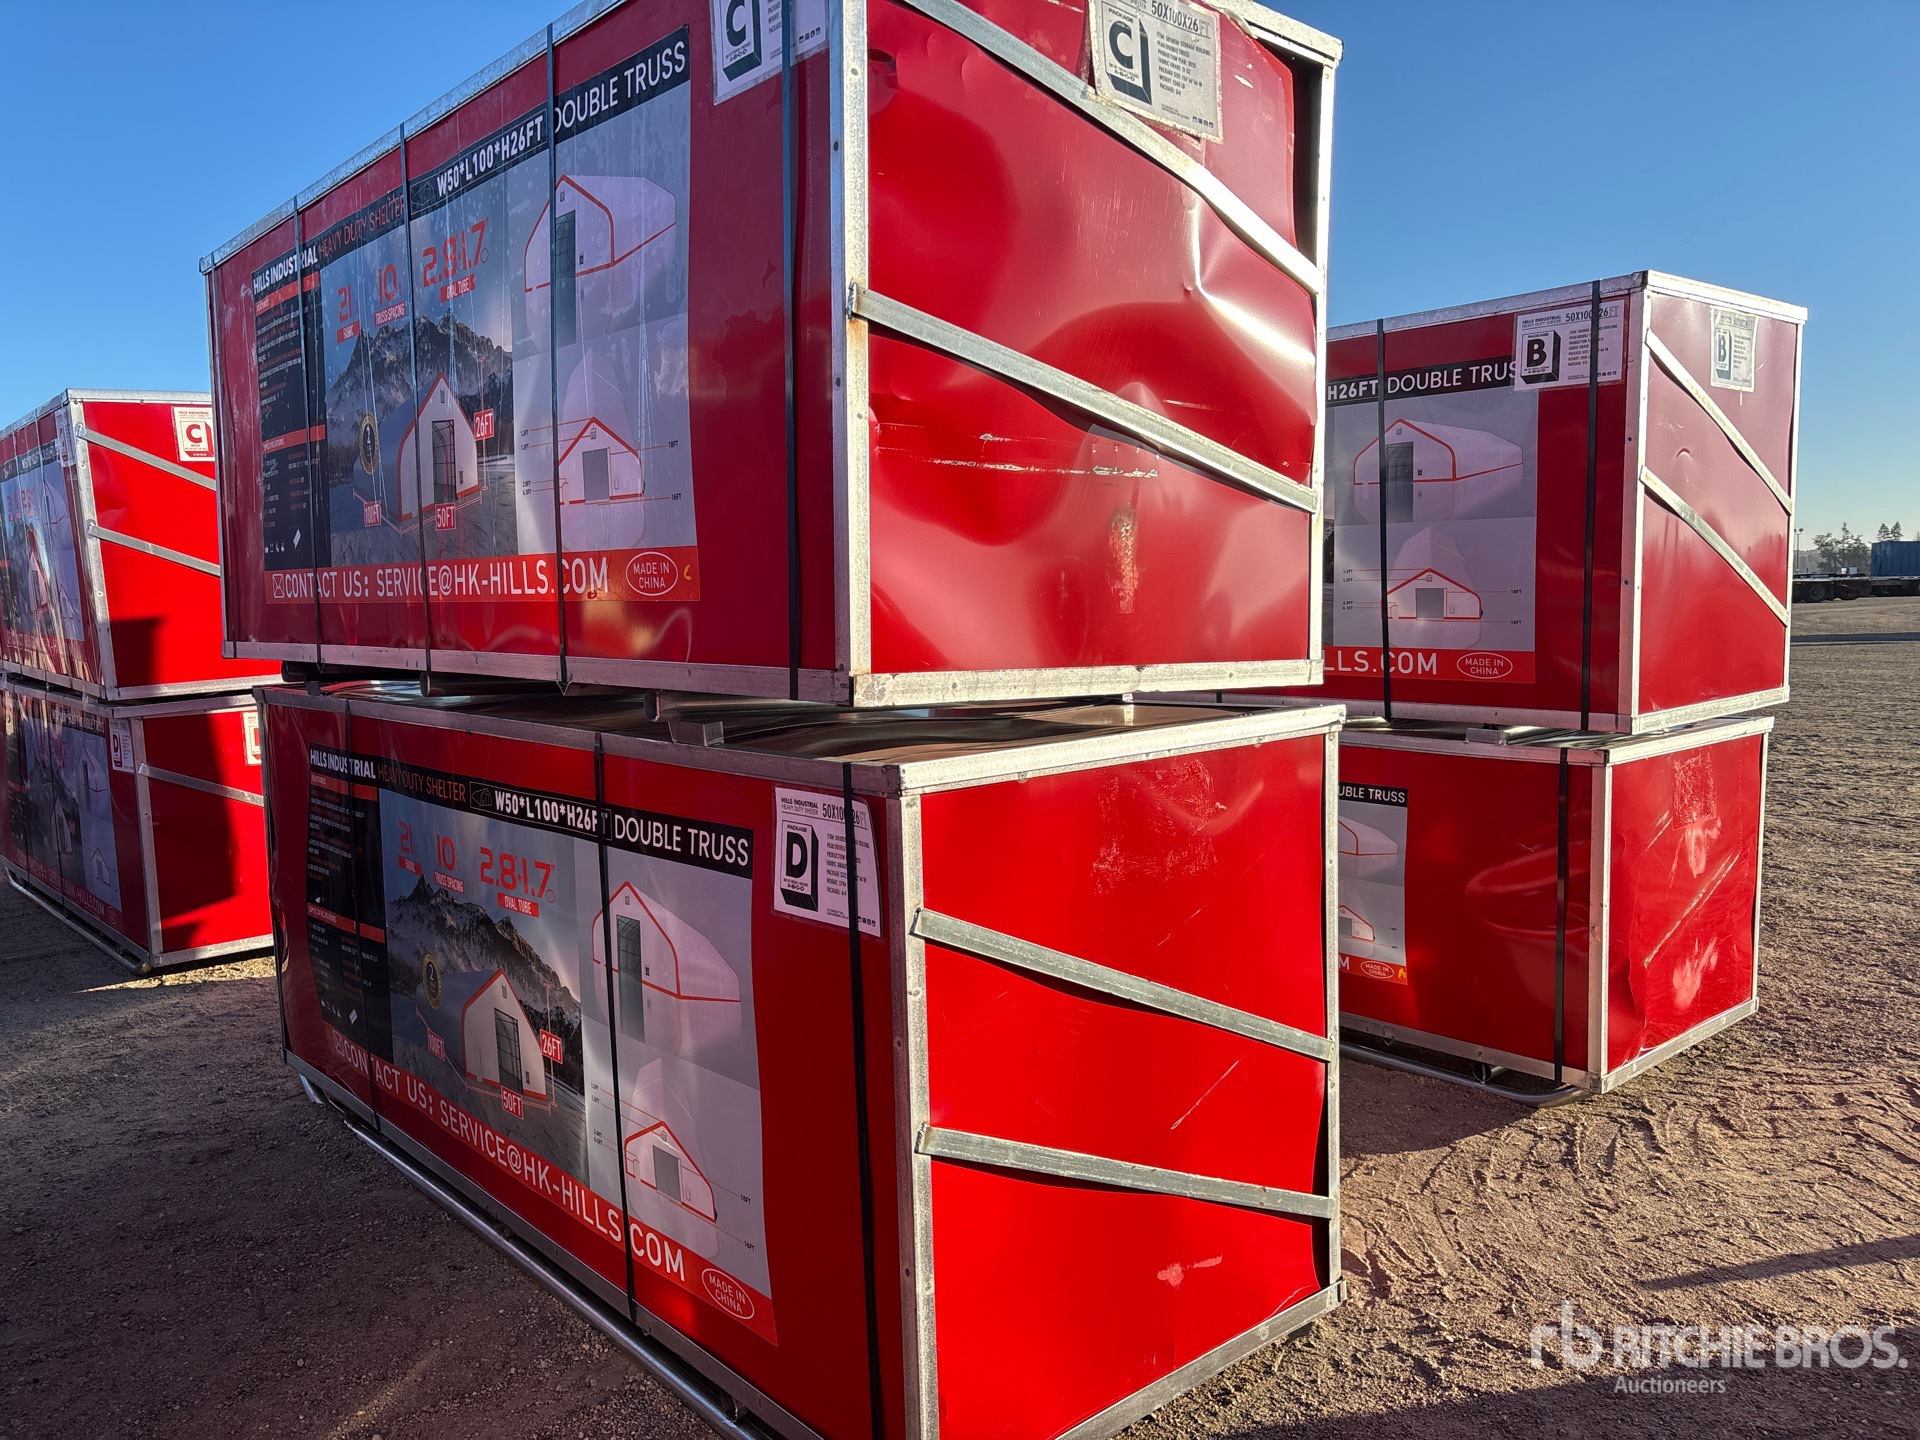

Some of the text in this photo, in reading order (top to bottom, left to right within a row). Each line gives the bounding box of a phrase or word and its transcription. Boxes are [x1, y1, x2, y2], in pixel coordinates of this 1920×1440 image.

[726, 0, 746, 47] C
[1109, 21, 1134, 70] C
[253, 271, 270, 295] HILLS
[318, 230, 342, 257] HEAVY
[344, 219, 367, 243] DUTY
[624, 40, 686, 98] TRUSS
[1526, 338, 1547, 368] B
[1387, 368, 1463, 394] DOUBLE
[186, 424, 203, 444] C
[475, 412, 493, 438] 26FT
[436, 505, 455, 528] 50FT
[633, 562, 670, 575] MADE IN
[343, 570, 369, 598] US:
[638, 577, 666, 589] CHINA
[1465, 657, 1504, 667] MADE IN
[1470, 666, 1499, 675] CHINA
[311, 749, 328, 768] HILLS
[328, 753, 376, 779] INDUSTRIAL
[402, 770, 424, 792] DUTY
[426, 776, 466, 803] SHELTER
[614, 814, 682, 852] DOUBLE
[688, 827, 749, 867] TRUSS
[793, 798, 818, 809] INDUSTRIAL
[1368, 788, 1405, 803] TRUSS
[787, 824, 807, 832] PACKAGE
[785, 831, 807, 878] D
[504, 895, 517, 911] OVAL
[518, 898, 532, 915] TUBE
[541, 1032, 563, 1063] 26FT
[502, 1090, 522, 1118] 50FT
[344, 1039, 686, 1282] CONACT US: SERVICE@HK-HILLSCOM
[708, 1273, 746, 1305] MADE IN
[715, 1290, 743, 1315] CHINA
